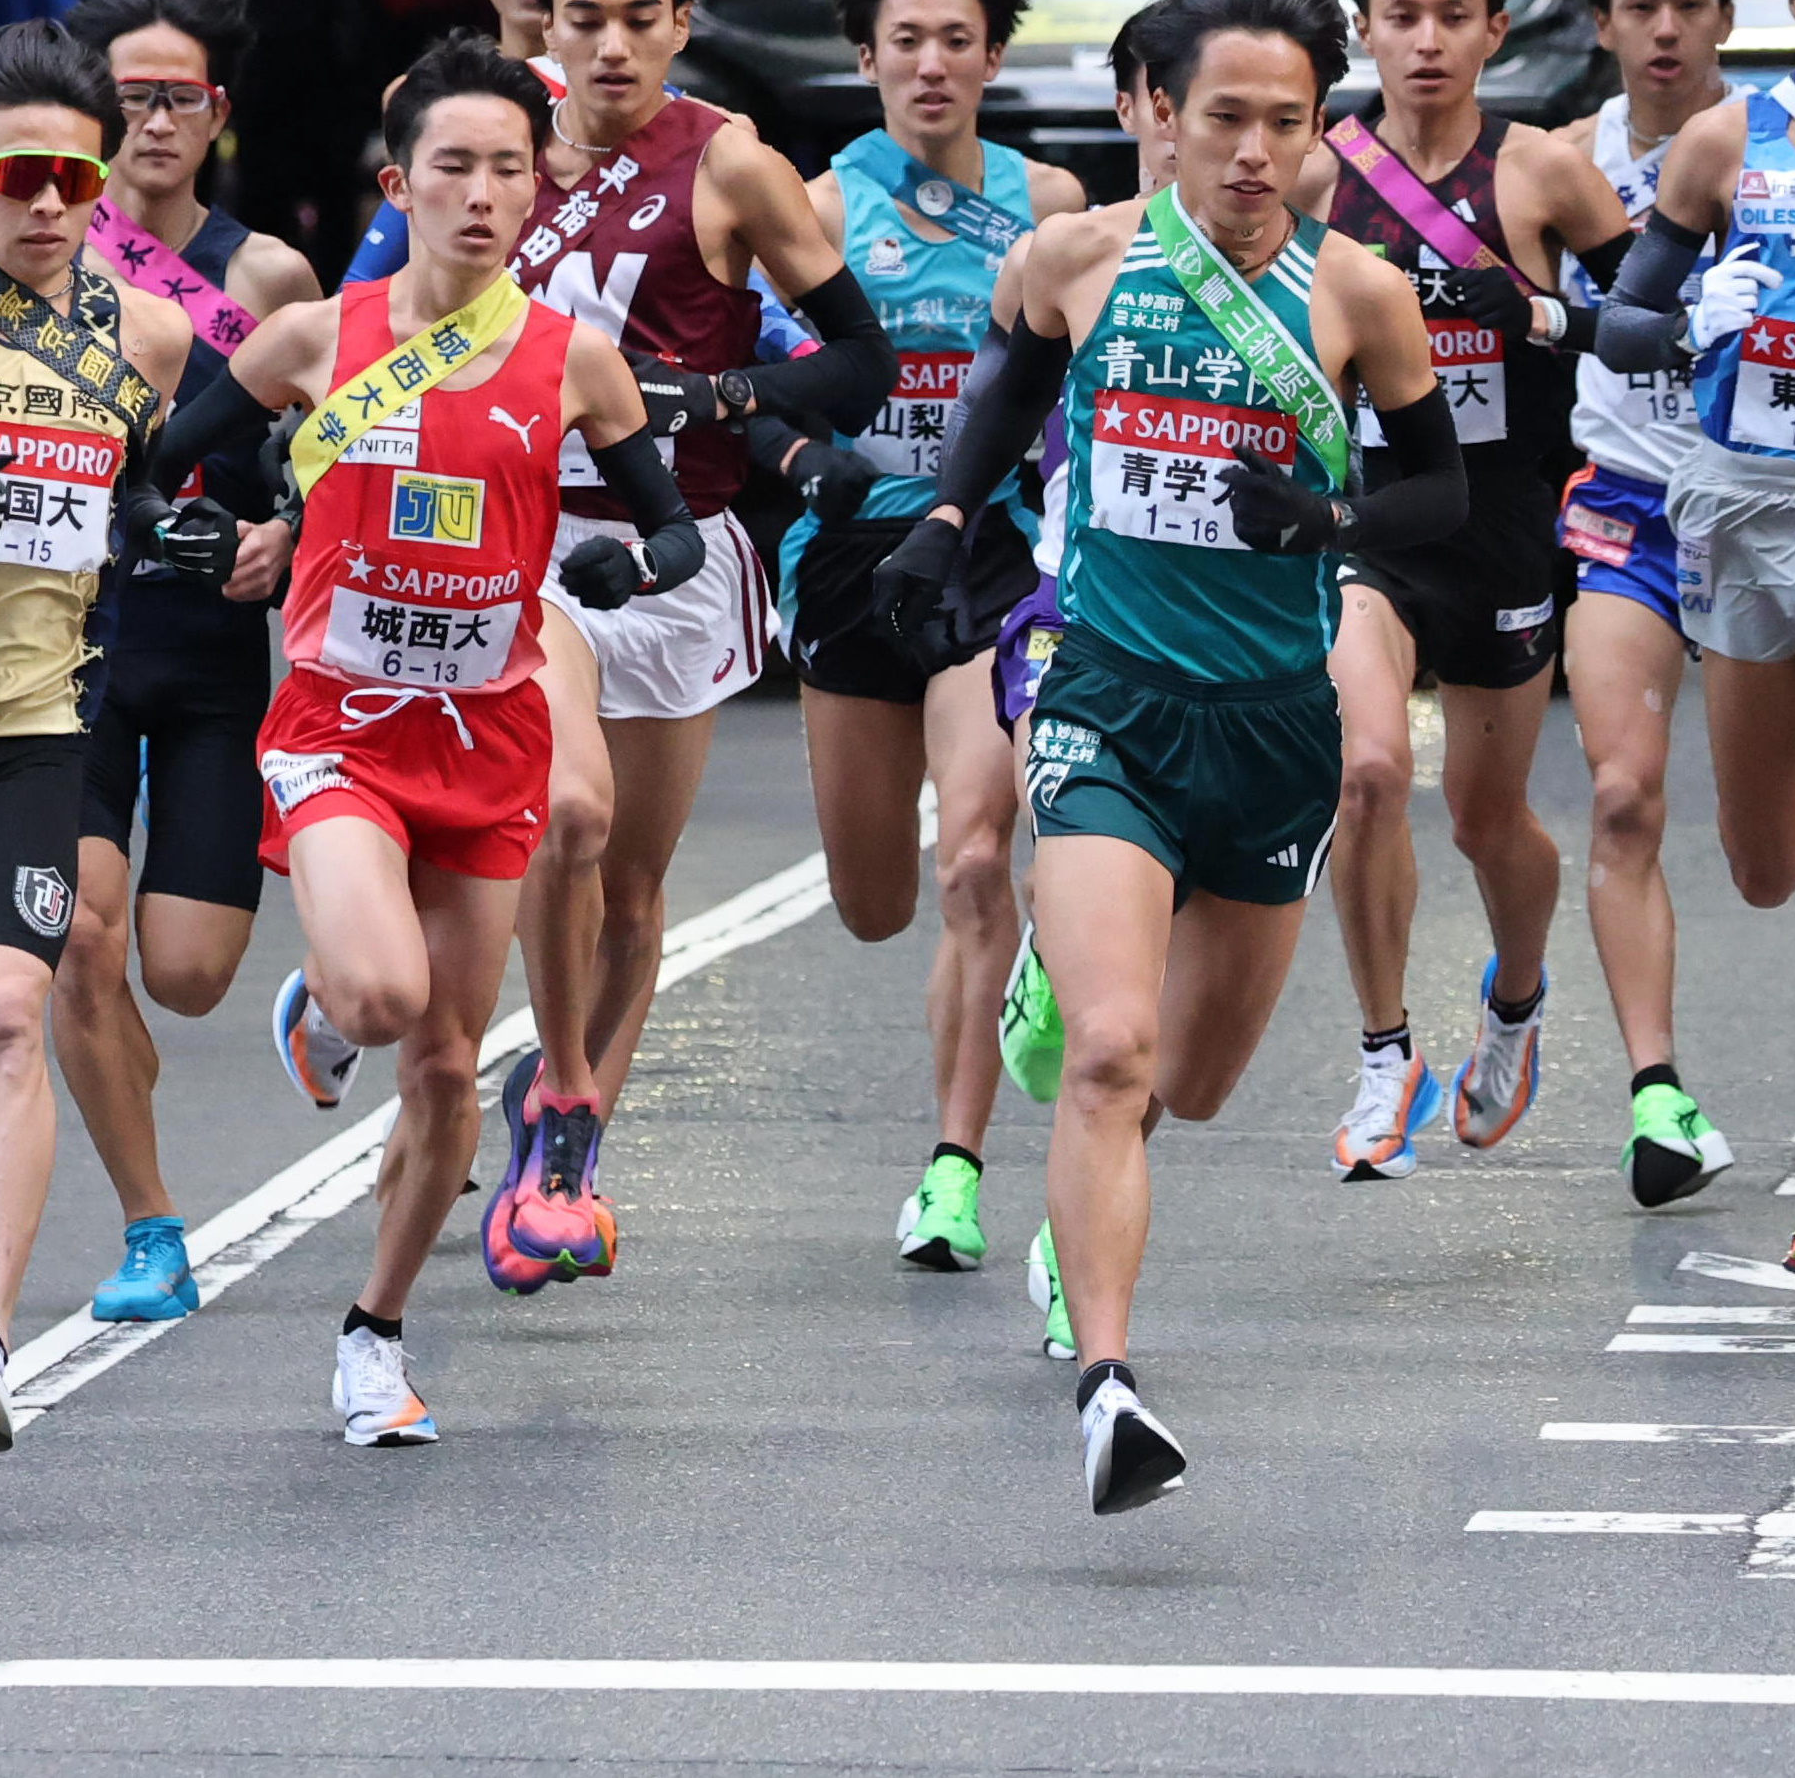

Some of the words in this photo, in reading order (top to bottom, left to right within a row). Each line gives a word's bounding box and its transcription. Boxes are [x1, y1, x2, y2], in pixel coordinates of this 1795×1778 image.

[956, 198, 1022, 252] 山梨
[1130, 311, 1181, 333] 水上村
[899, 363, 971, 390] SAPP
[1194, 272, 1340, 448] 青山学院大学
[317, 320, 472, 448] 城西大学
[639, 381, 685, 397] WASEDA
[359, 438, 413, 456] NITTA
[1134, 407, 1286, 453] SAPPORO
[4, 479, 89, 532] 国大
[1144, 502, 1220, 544] 1-16
[3, 537, 54, 564] -15
[381, 563, 520, 602] SAPPORO
[361, 601, 492, 651] 城西大
[382, 651, 459, 683] 6-13
